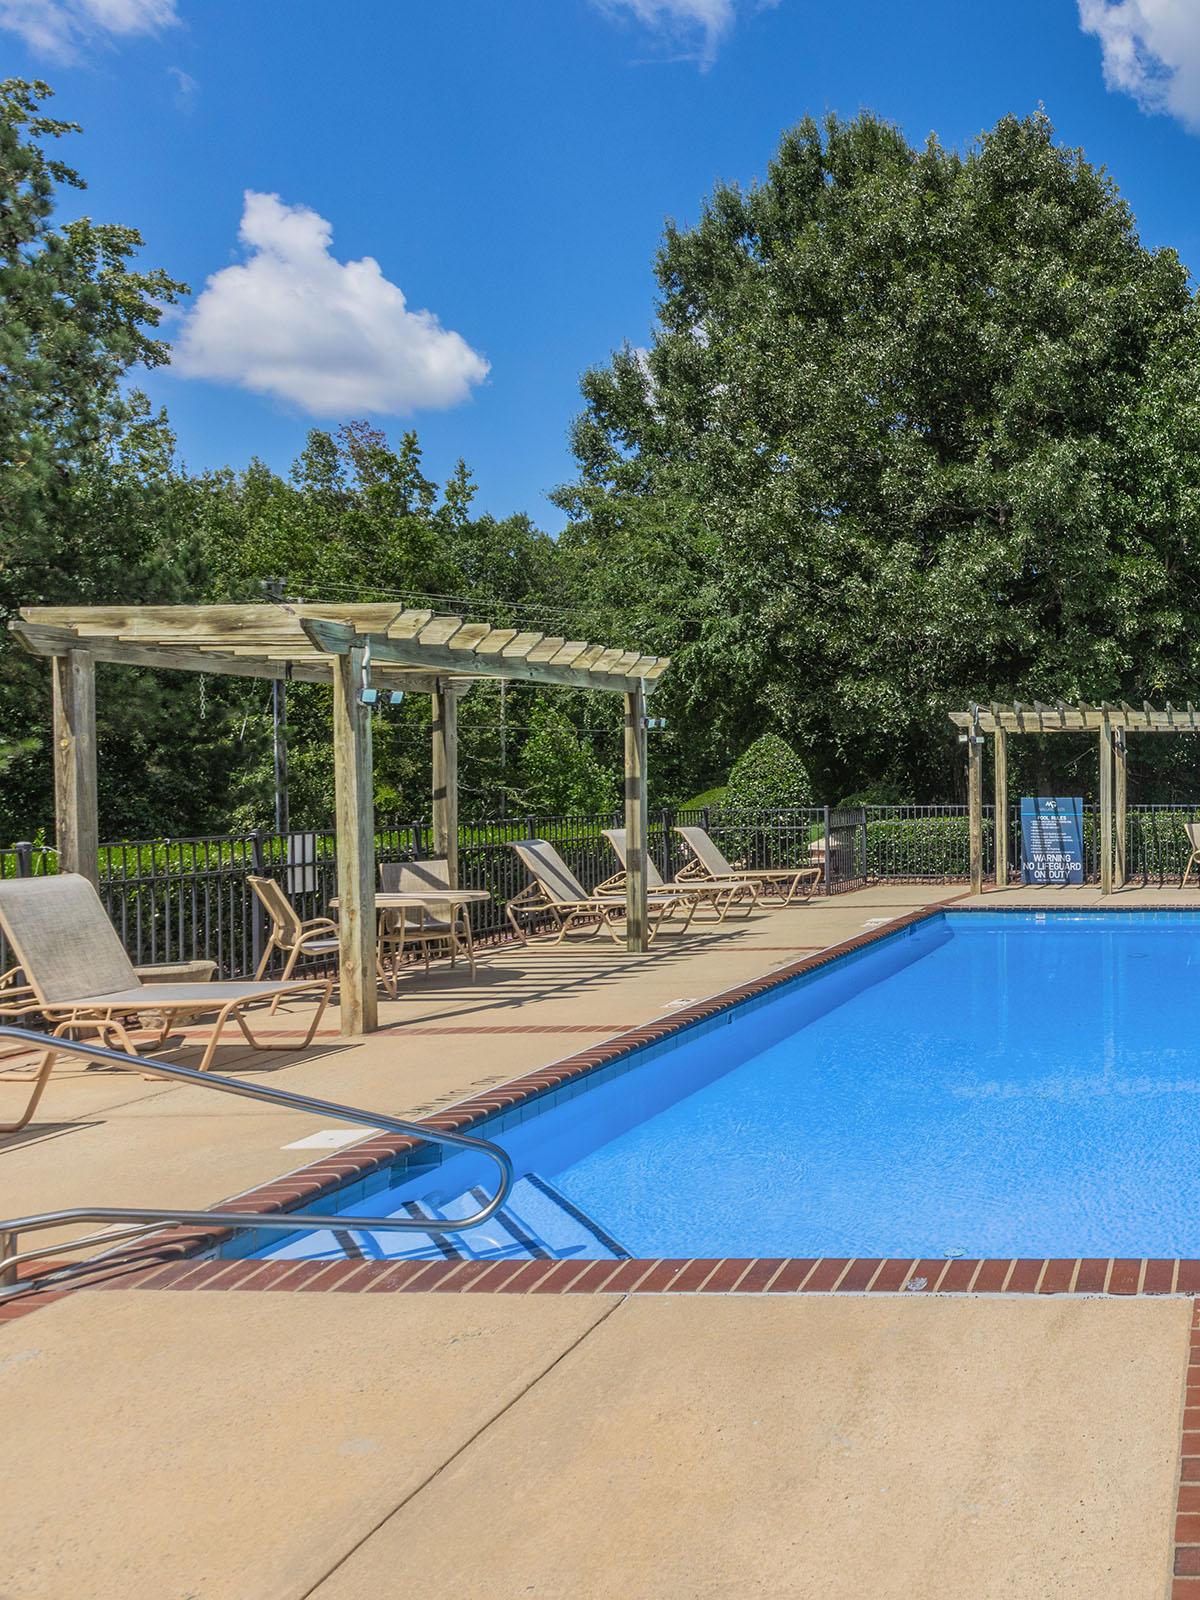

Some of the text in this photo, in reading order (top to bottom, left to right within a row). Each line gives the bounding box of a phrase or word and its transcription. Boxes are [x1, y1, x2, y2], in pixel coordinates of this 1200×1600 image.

[1033, 854, 1072, 863] WARNING
[1023, 862, 1082, 871] NO LIFEGUARD
[1034, 870, 1071, 879] ON DUTY
